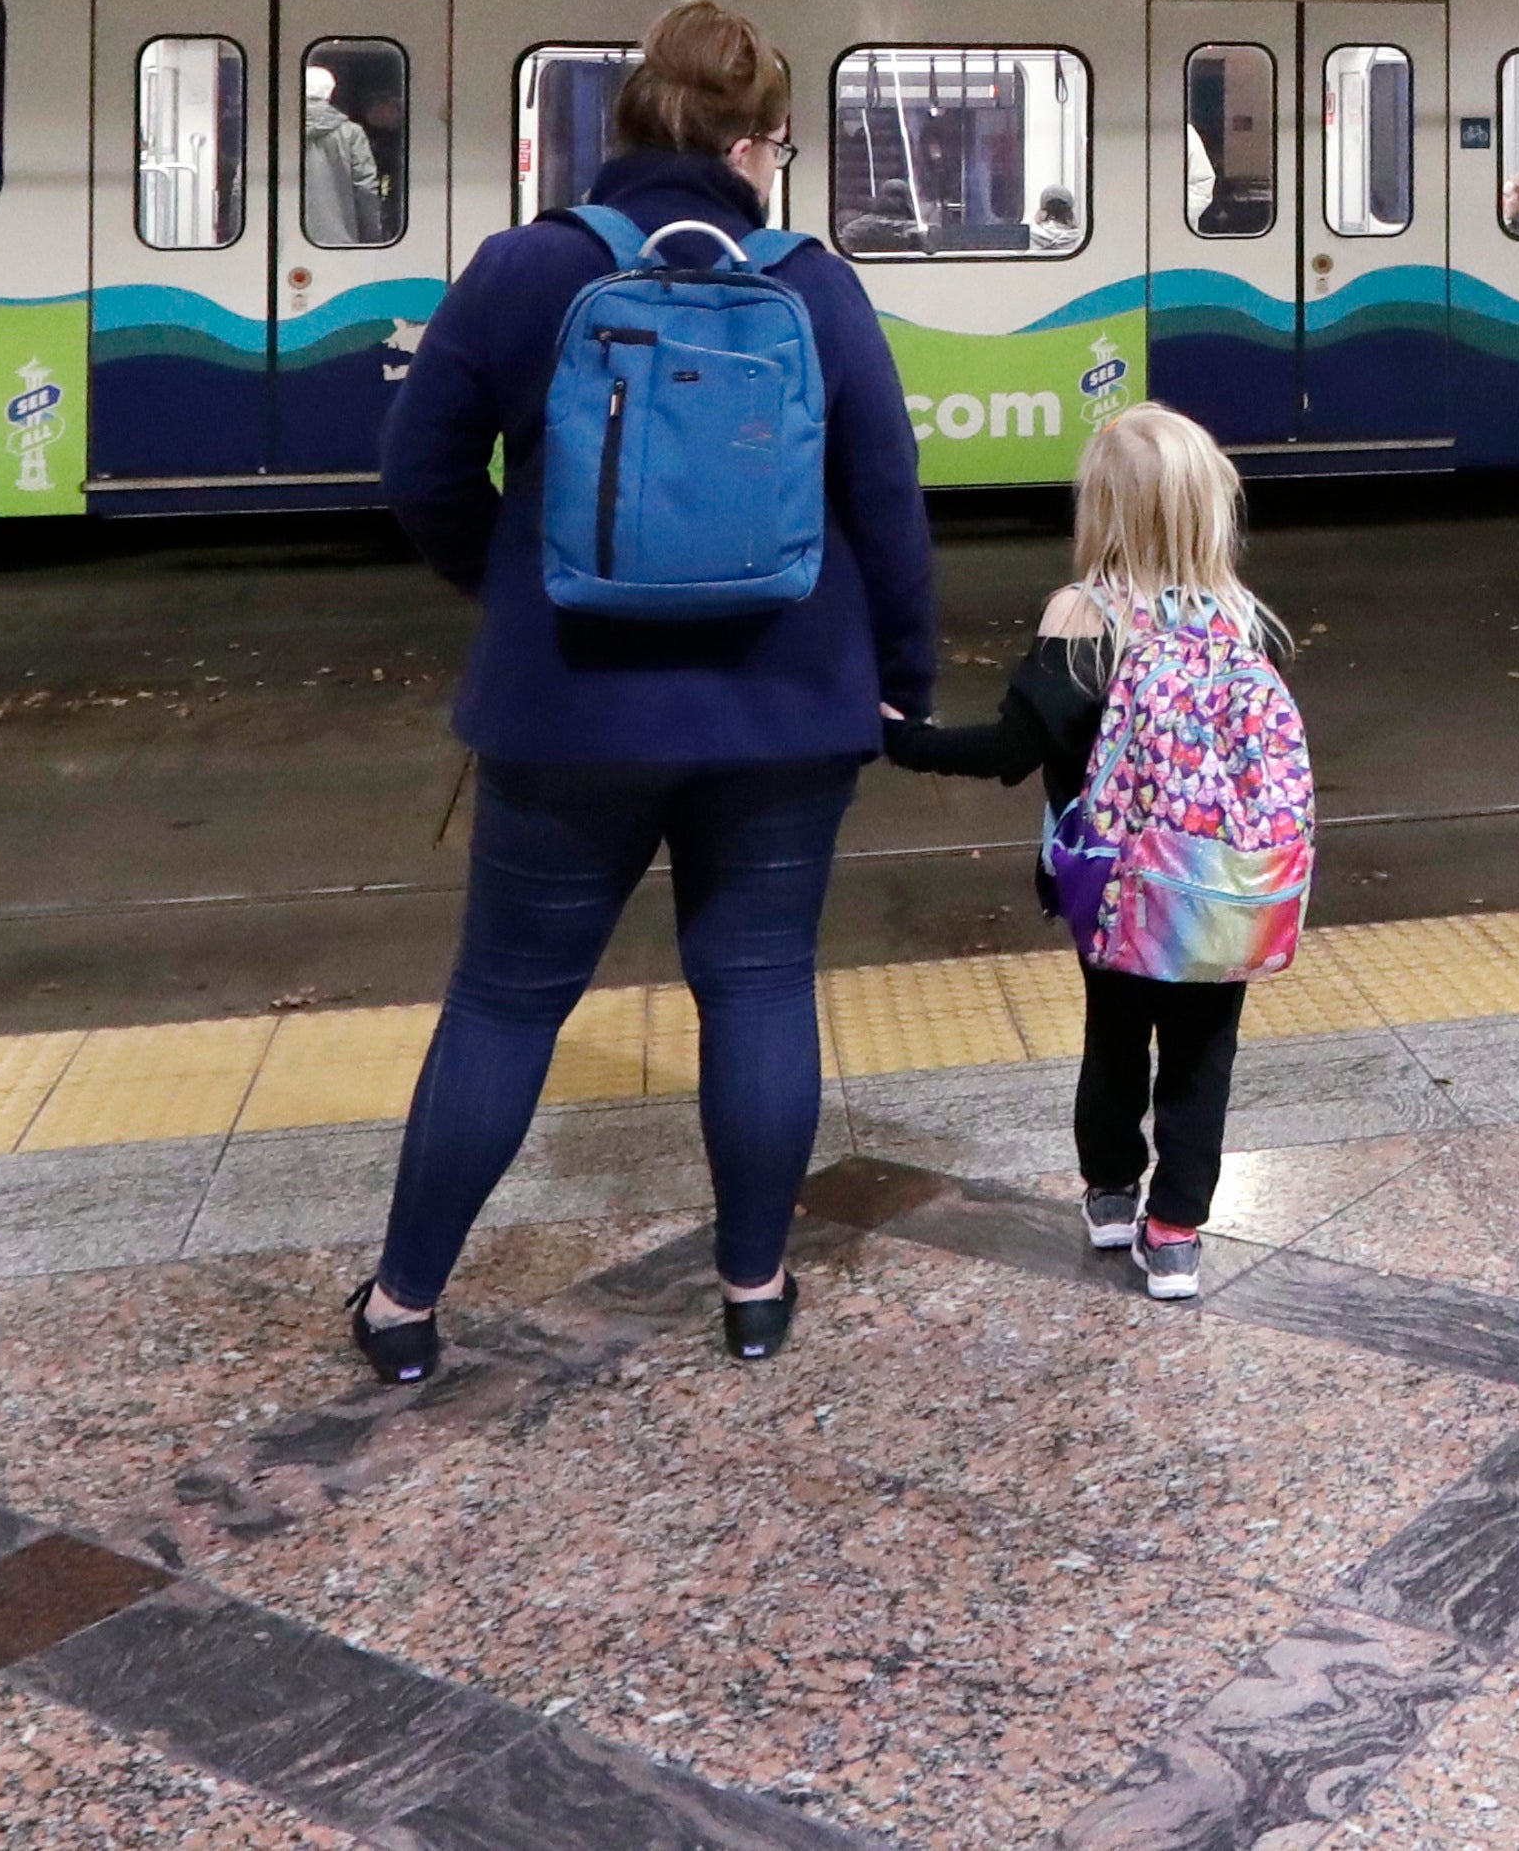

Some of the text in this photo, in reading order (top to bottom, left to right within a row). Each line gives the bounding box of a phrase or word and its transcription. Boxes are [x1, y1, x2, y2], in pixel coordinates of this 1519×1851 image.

[1089, 363, 1117, 388] SEE
[17, 389, 50, 416] SEE
[1092, 395, 1119, 417] ALL
[21, 424, 52, 449] ALL
